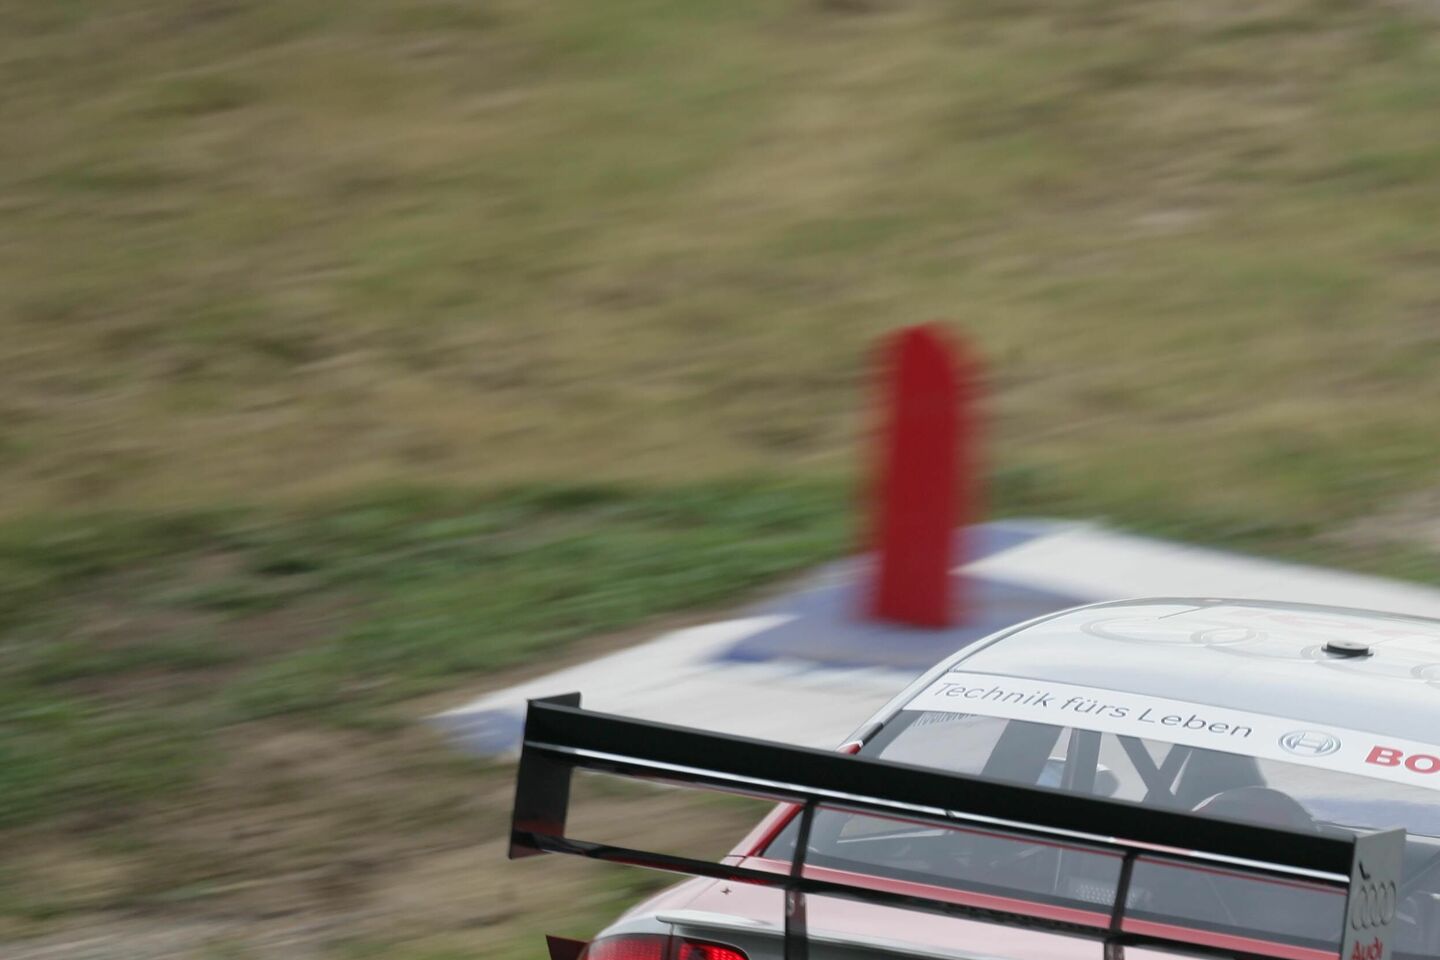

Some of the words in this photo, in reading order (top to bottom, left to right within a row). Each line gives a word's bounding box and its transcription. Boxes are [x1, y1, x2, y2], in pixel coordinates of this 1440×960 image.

[933, 682, 1056, 708] Technik
[1060, 696, 1128, 719] fürs
[1137, 708, 1254, 738] Leben
